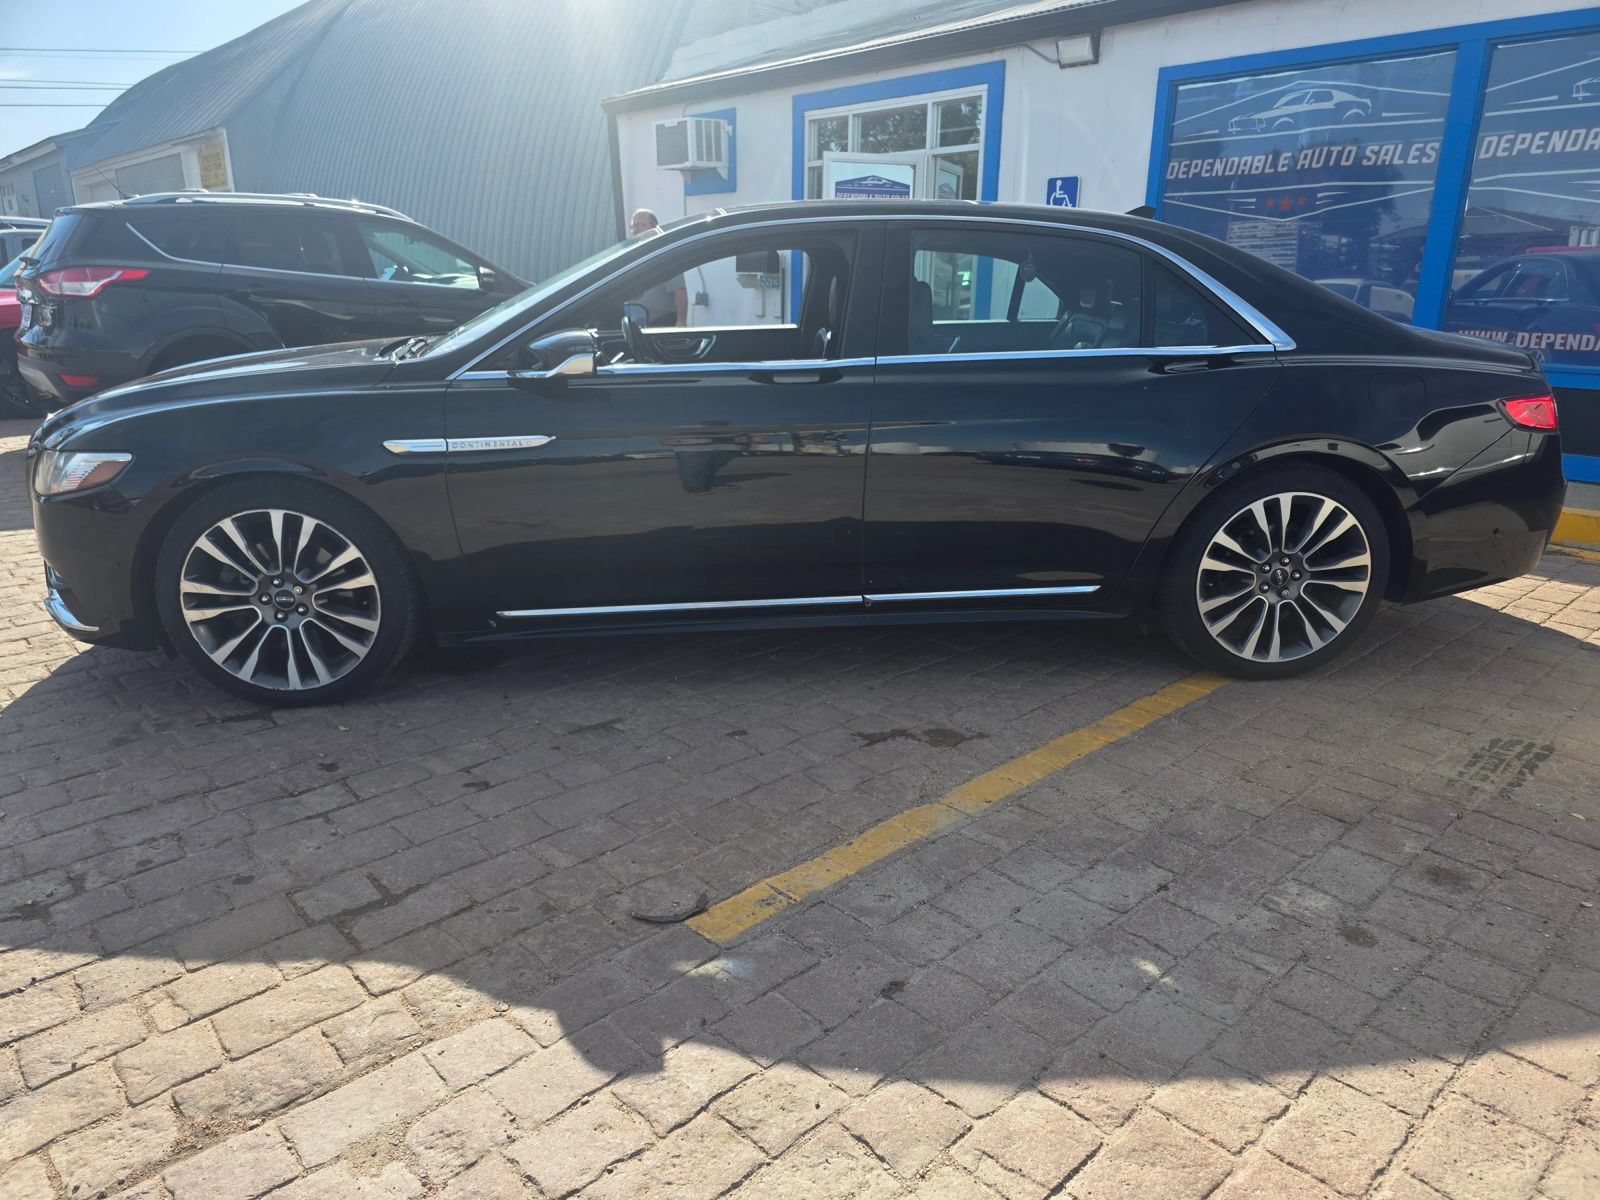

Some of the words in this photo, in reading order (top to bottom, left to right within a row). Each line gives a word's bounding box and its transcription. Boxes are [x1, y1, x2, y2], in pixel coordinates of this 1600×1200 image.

[1166, 153, 1292, 180] DEPENDABLE
[1296, 145, 1356, 170] AUTO
[1362, 142, 1441, 166] SALES
[1459, 330, 1600, 351] WDEPEND
[452, 440, 524, 449] CONTINENTAL
